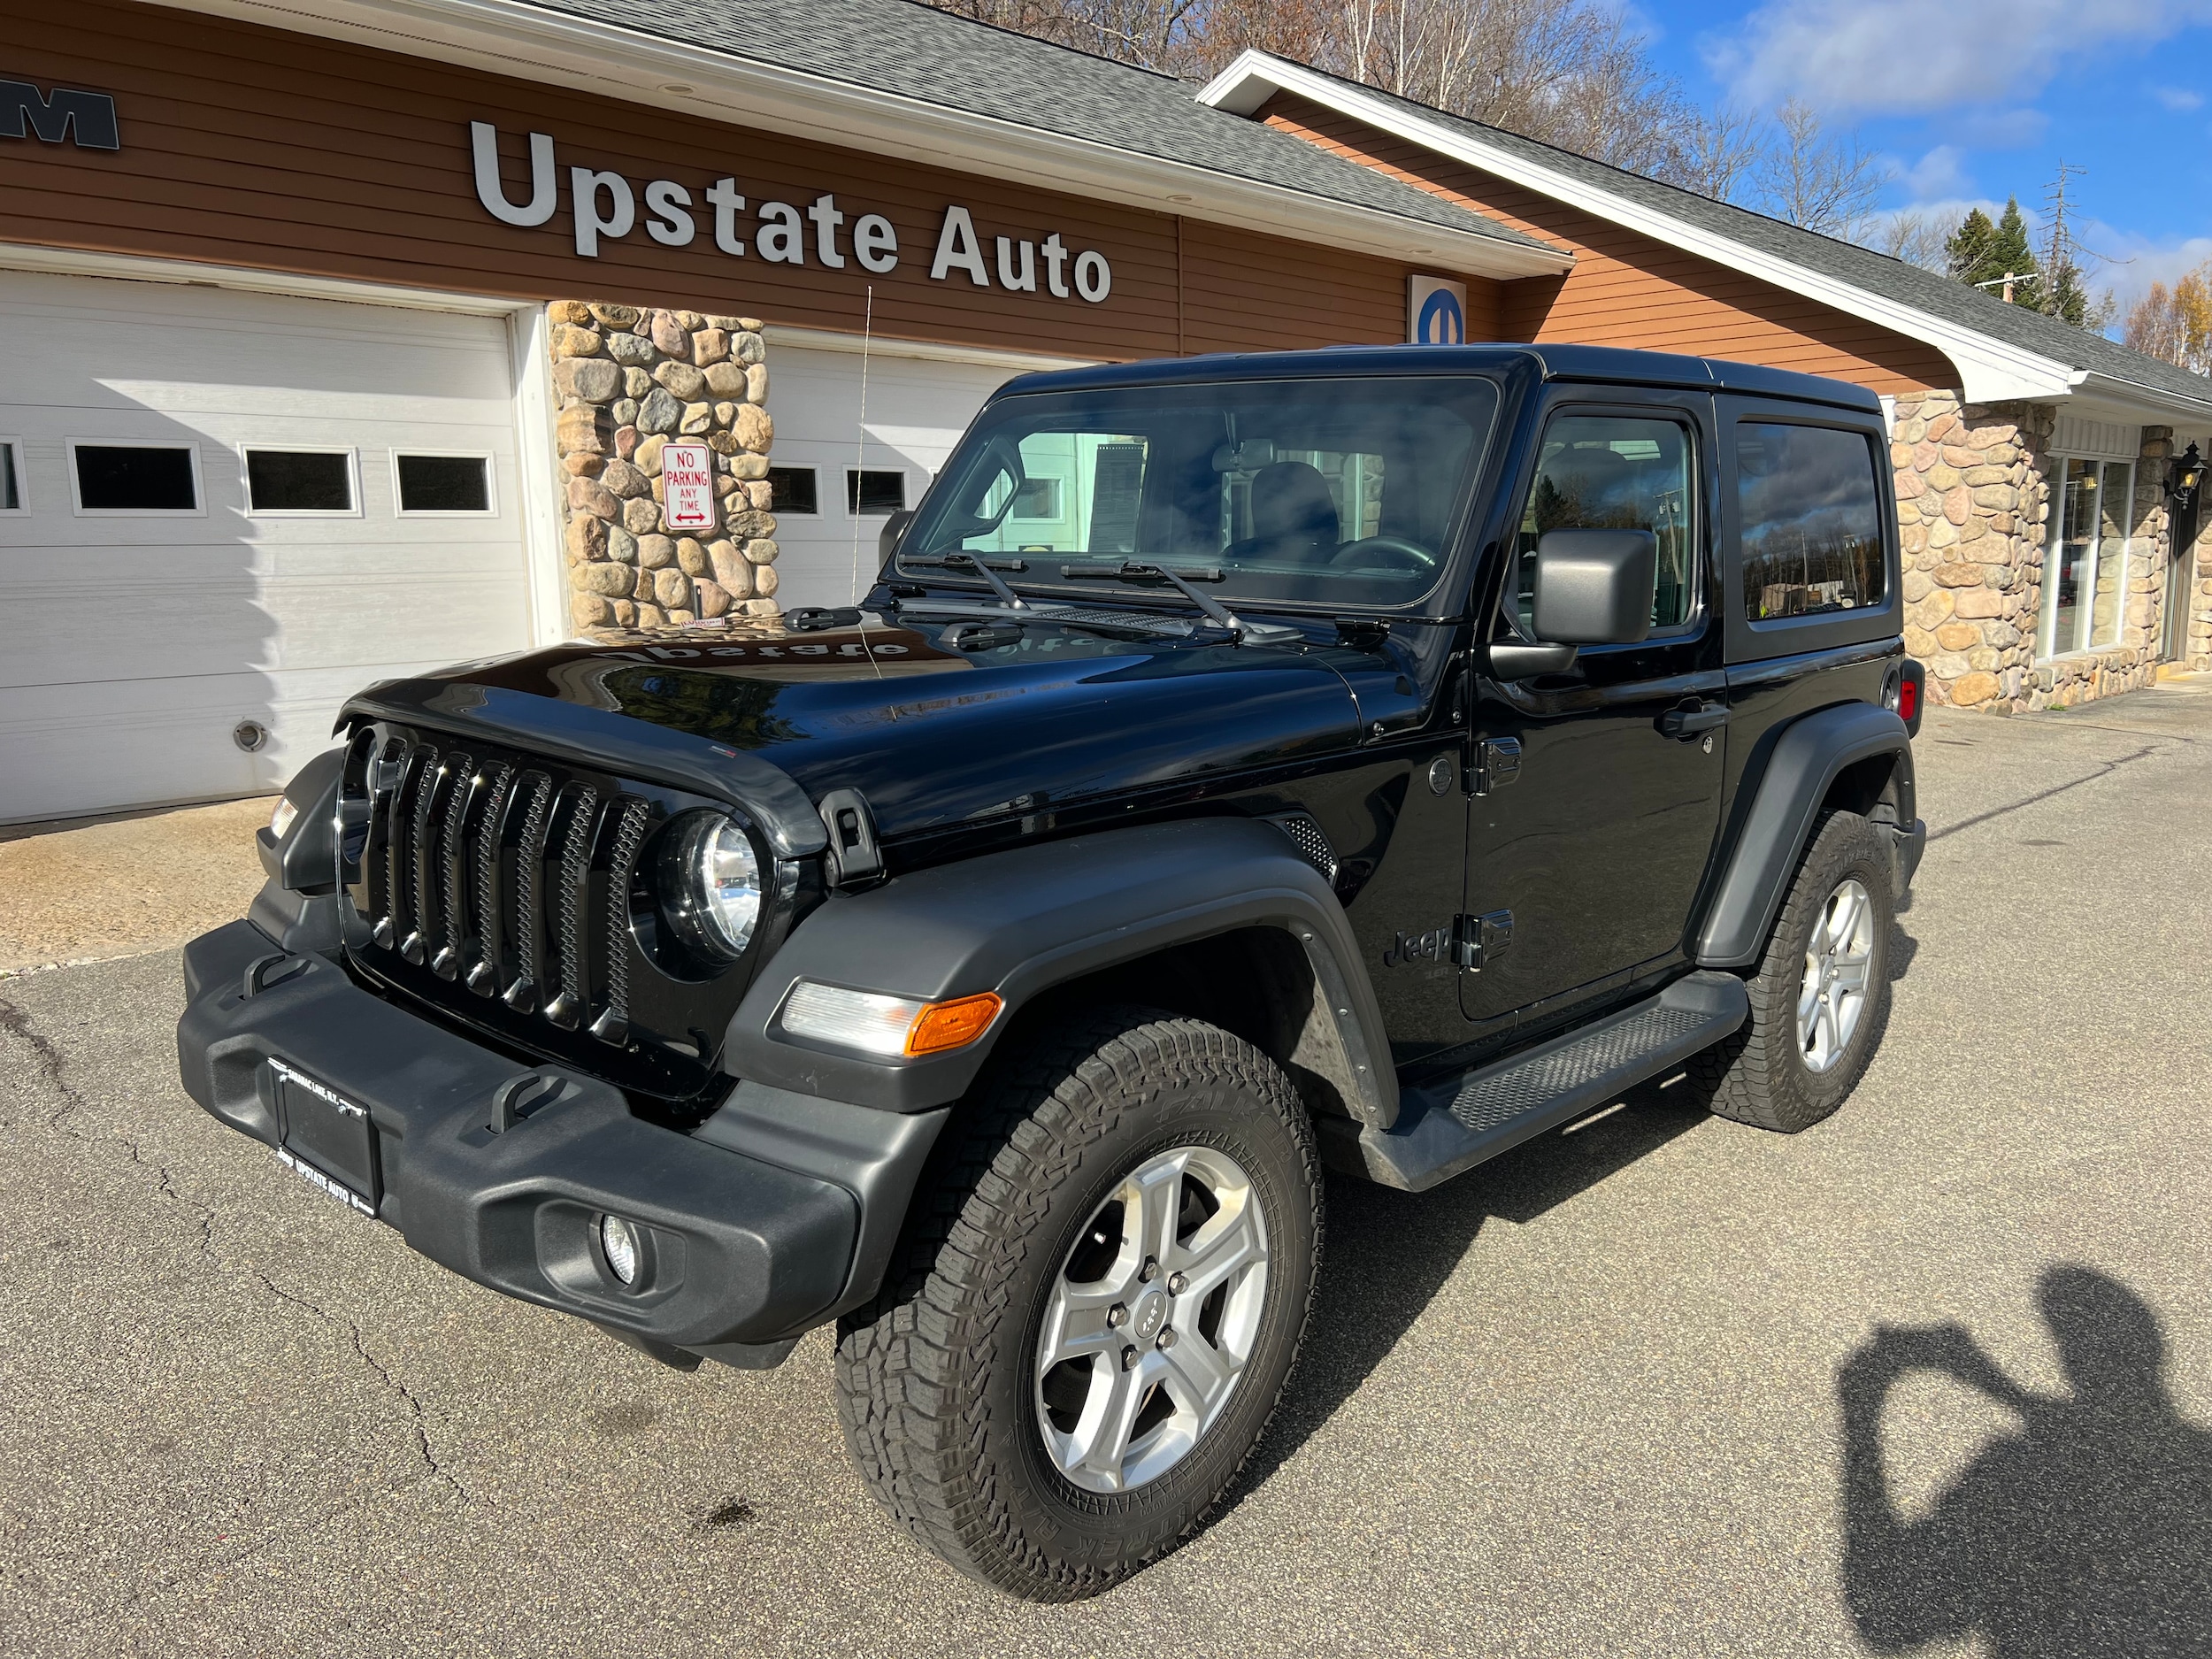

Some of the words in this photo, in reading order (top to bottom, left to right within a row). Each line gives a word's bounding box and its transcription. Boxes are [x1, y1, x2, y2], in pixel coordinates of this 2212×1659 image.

[470, 120, 900, 273] Upstate
[930, 204, 1112, 303] Auto
[677, 452, 695, 468] NO
[667, 471, 707, 487] PARKING
[680, 488, 697, 499] ANY
[680, 500, 700, 511] TIME
[1384, 926, 1452, 967] Jeep
[288, 1068, 312, 1091] SARANAC
[296, 1159, 327, 1191] UPSTATE
[327, 1180, 349, 1203] AUTO
